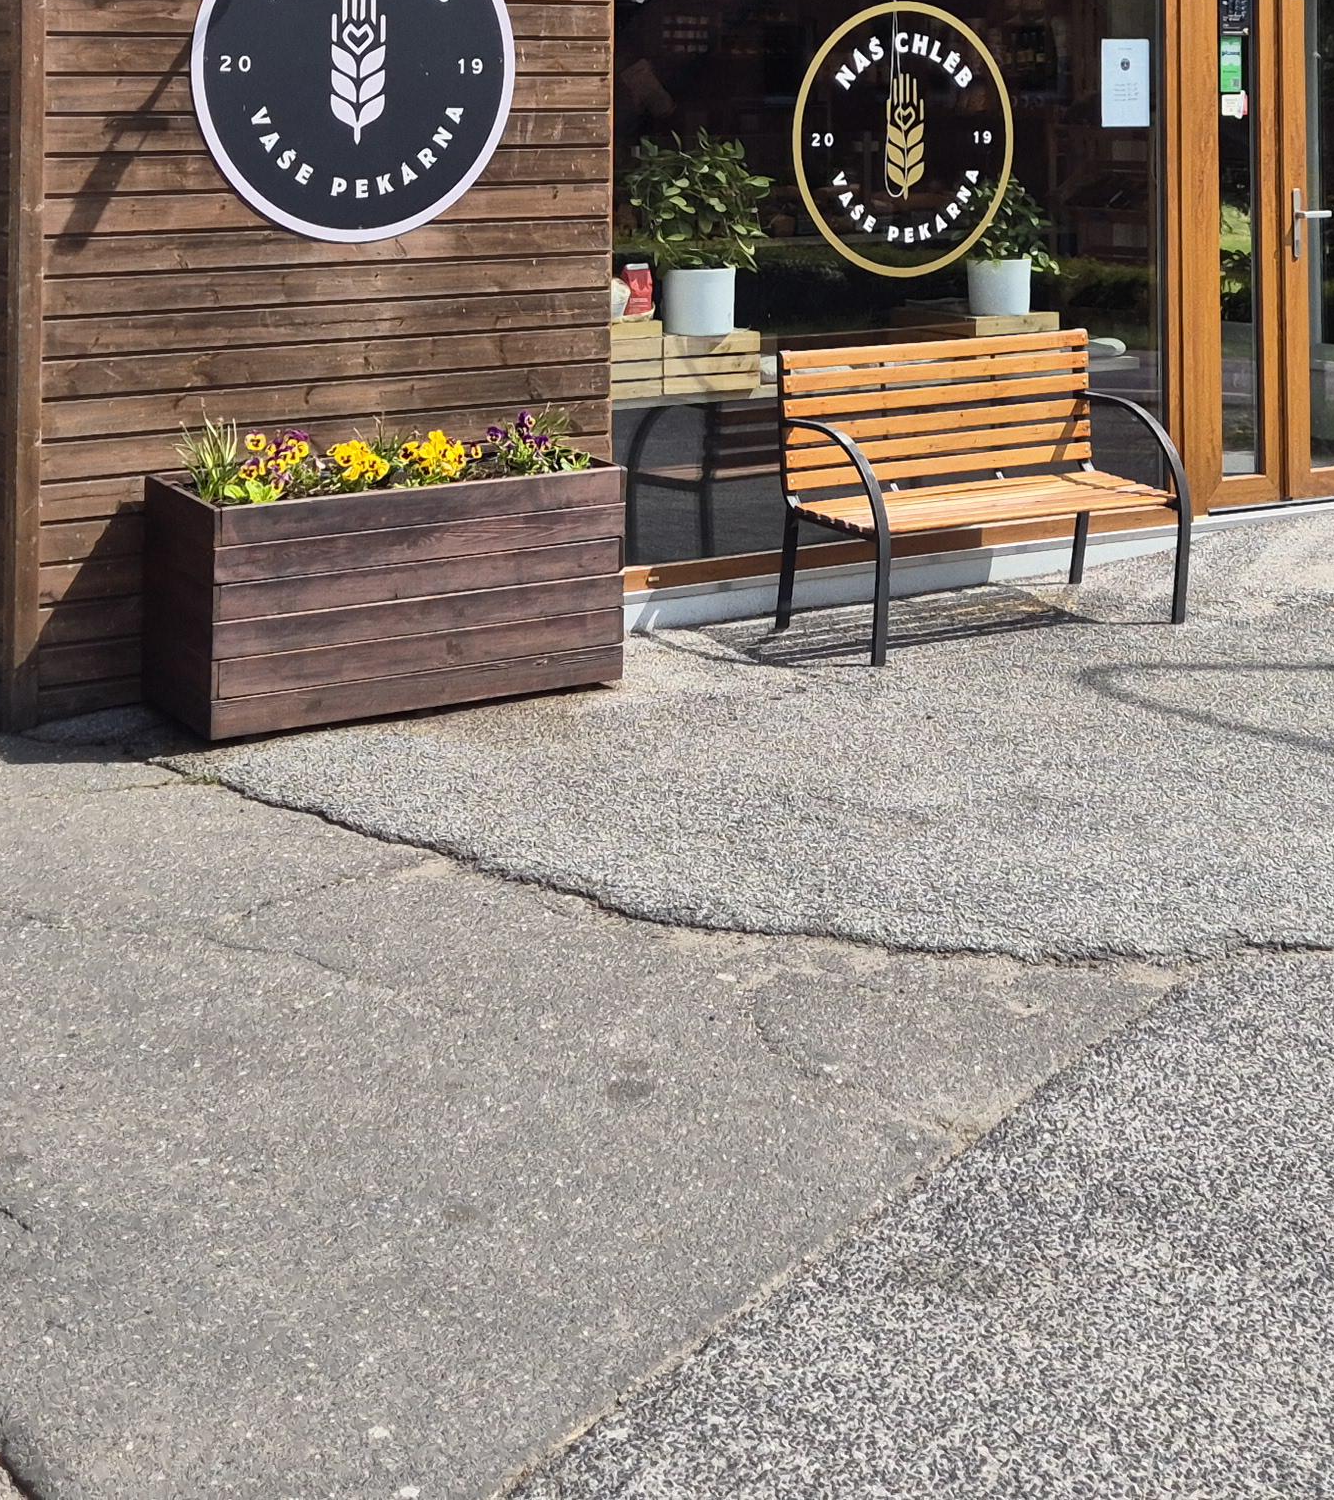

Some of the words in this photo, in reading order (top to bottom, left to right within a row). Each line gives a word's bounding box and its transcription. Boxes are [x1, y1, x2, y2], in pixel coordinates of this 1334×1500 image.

[219, 55, 252, 72] 20
[457, 58, 484, 75] 19
[835, 36, 884, 90] NÁŠ
[895, 32, 973, 88] CHLÉB
[250, 106, 314, 185] VAŠE
[330, 105, 464, 198] PEKÁRNA
[811, 133, 834, 147] 20
[973, 130, 992, 145] 19
[832, 171, 877, 232] VAŠE
[887, 169, 979, 243] PEKÁRNA
